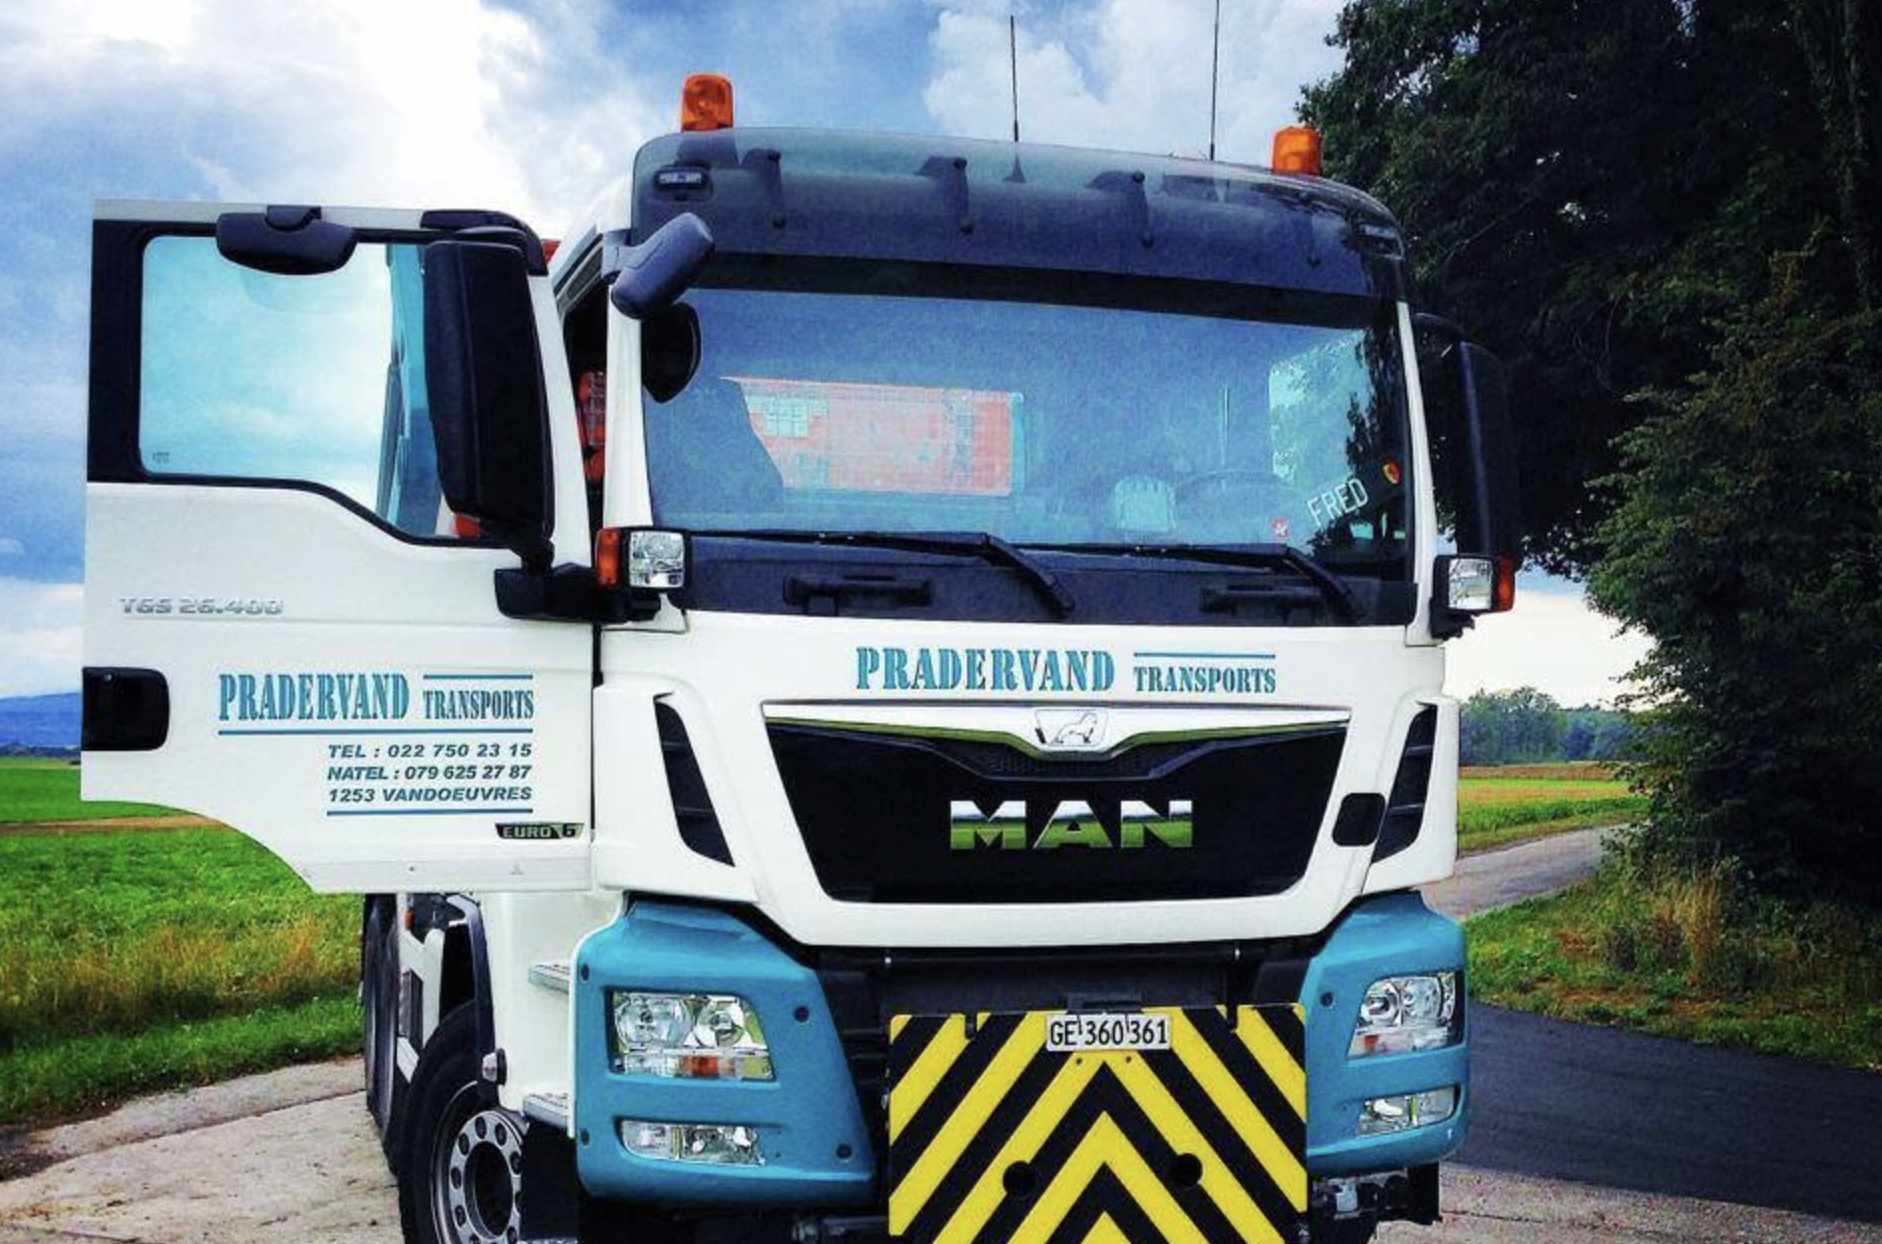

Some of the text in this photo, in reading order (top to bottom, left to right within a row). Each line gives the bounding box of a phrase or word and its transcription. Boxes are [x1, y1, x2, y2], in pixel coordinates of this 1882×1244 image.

[1306, 478, 1369, 527] FRED
[120, 598, 172, 614] TGS
[856, 646, 1276, 694] PRADERVAND TRANSPORTS
[218, 673, 534, 721] PRADERVAND TRANSPORTS
[327, 744, 366, 758] TEL
[387, 744, 425, 758] 022
[433, 743, 470, 758] 750
[476, 743, 501, 758] 23
[509, 743, 533, 758] 15
[326, 766, 389, 781] NATEL
[404, 765, 439, 780] 079
[443, 765, 477, 780] 625
[481, 765, 505, 780] 27
[508, 764, 532, 780] 87
[328, 786, 533, 802] 1253 VANDOEUVRES
[501, 825, 577, 839] EURO 6
[949, 800, 1194, 850] MAN
